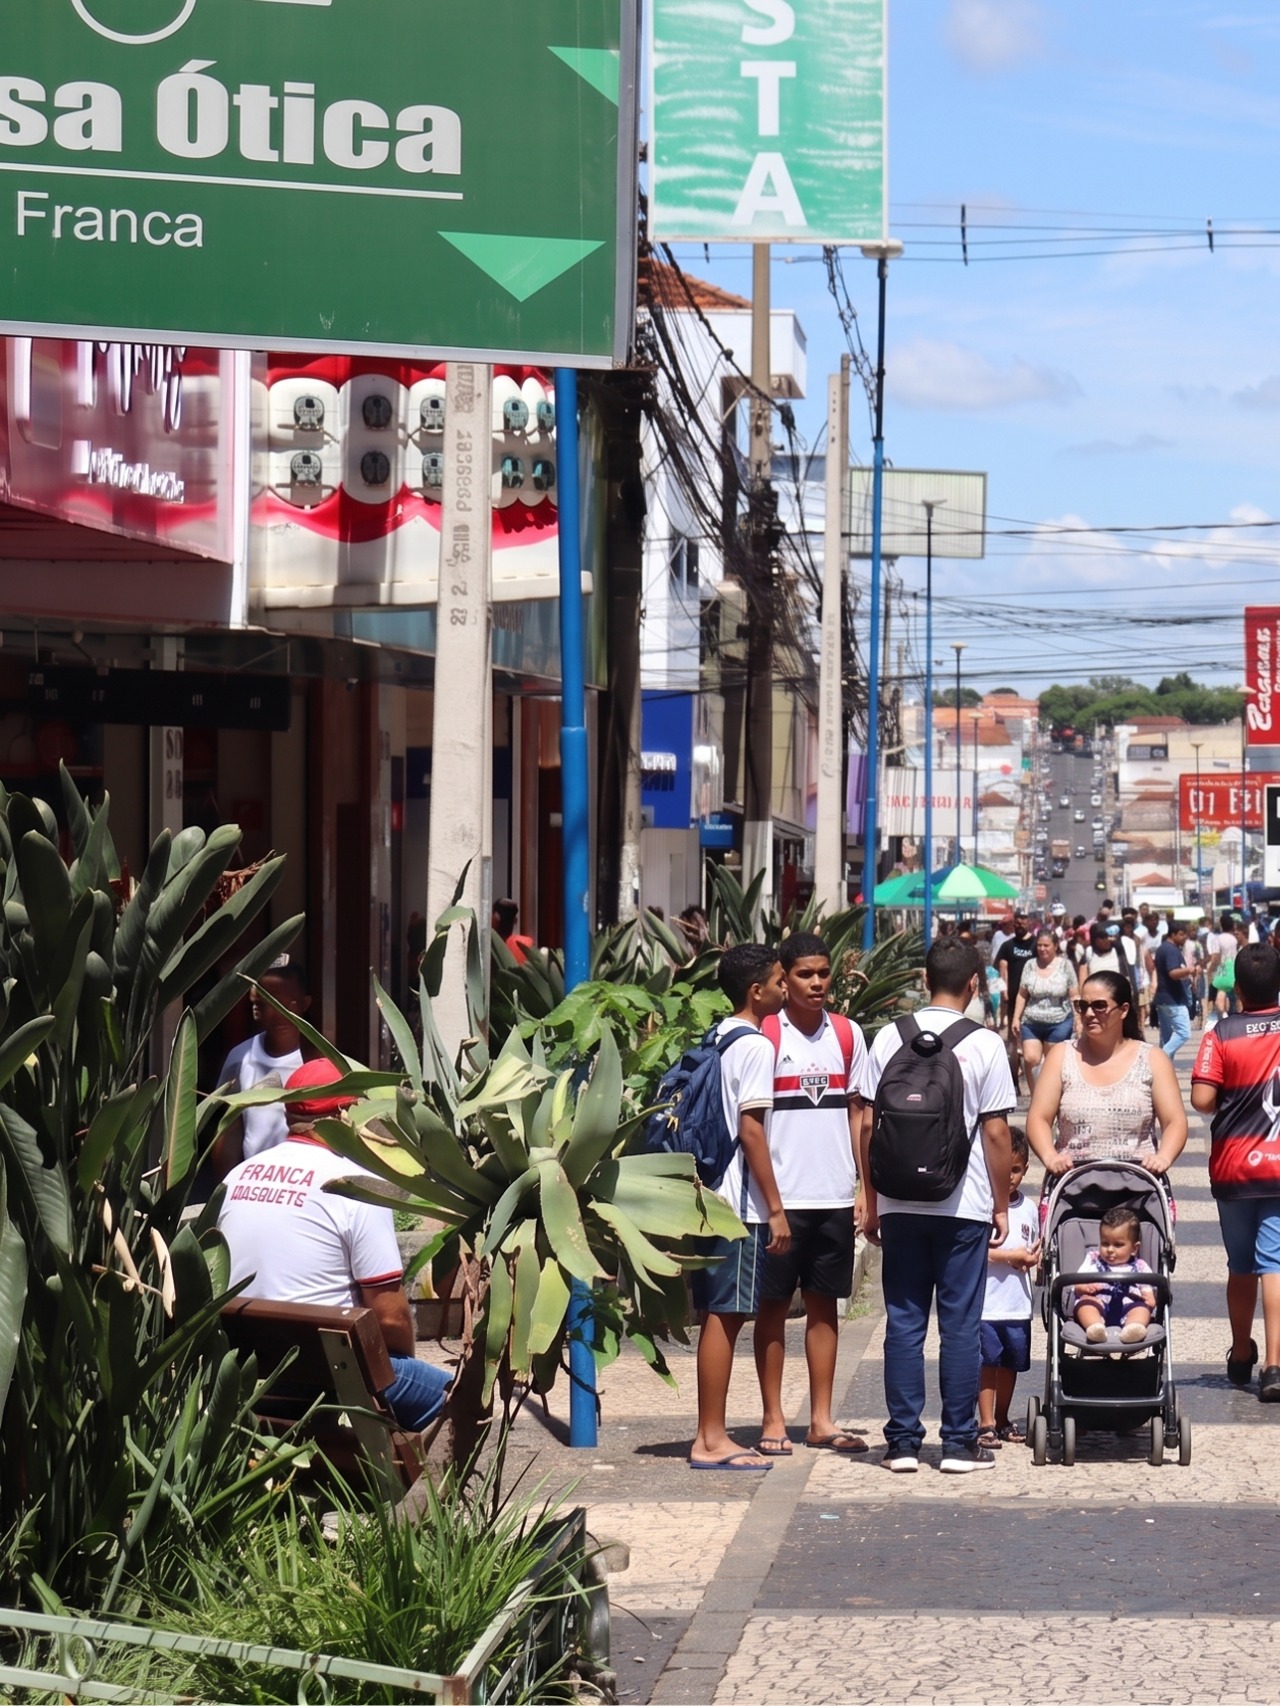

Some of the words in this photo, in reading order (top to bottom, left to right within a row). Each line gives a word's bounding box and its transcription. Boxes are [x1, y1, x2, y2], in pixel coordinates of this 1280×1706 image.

[156, 59, 462, 175] Ótica
[16, 190, 205, 248] Franca
[239, 1163, 315, 1187] FRANCA
